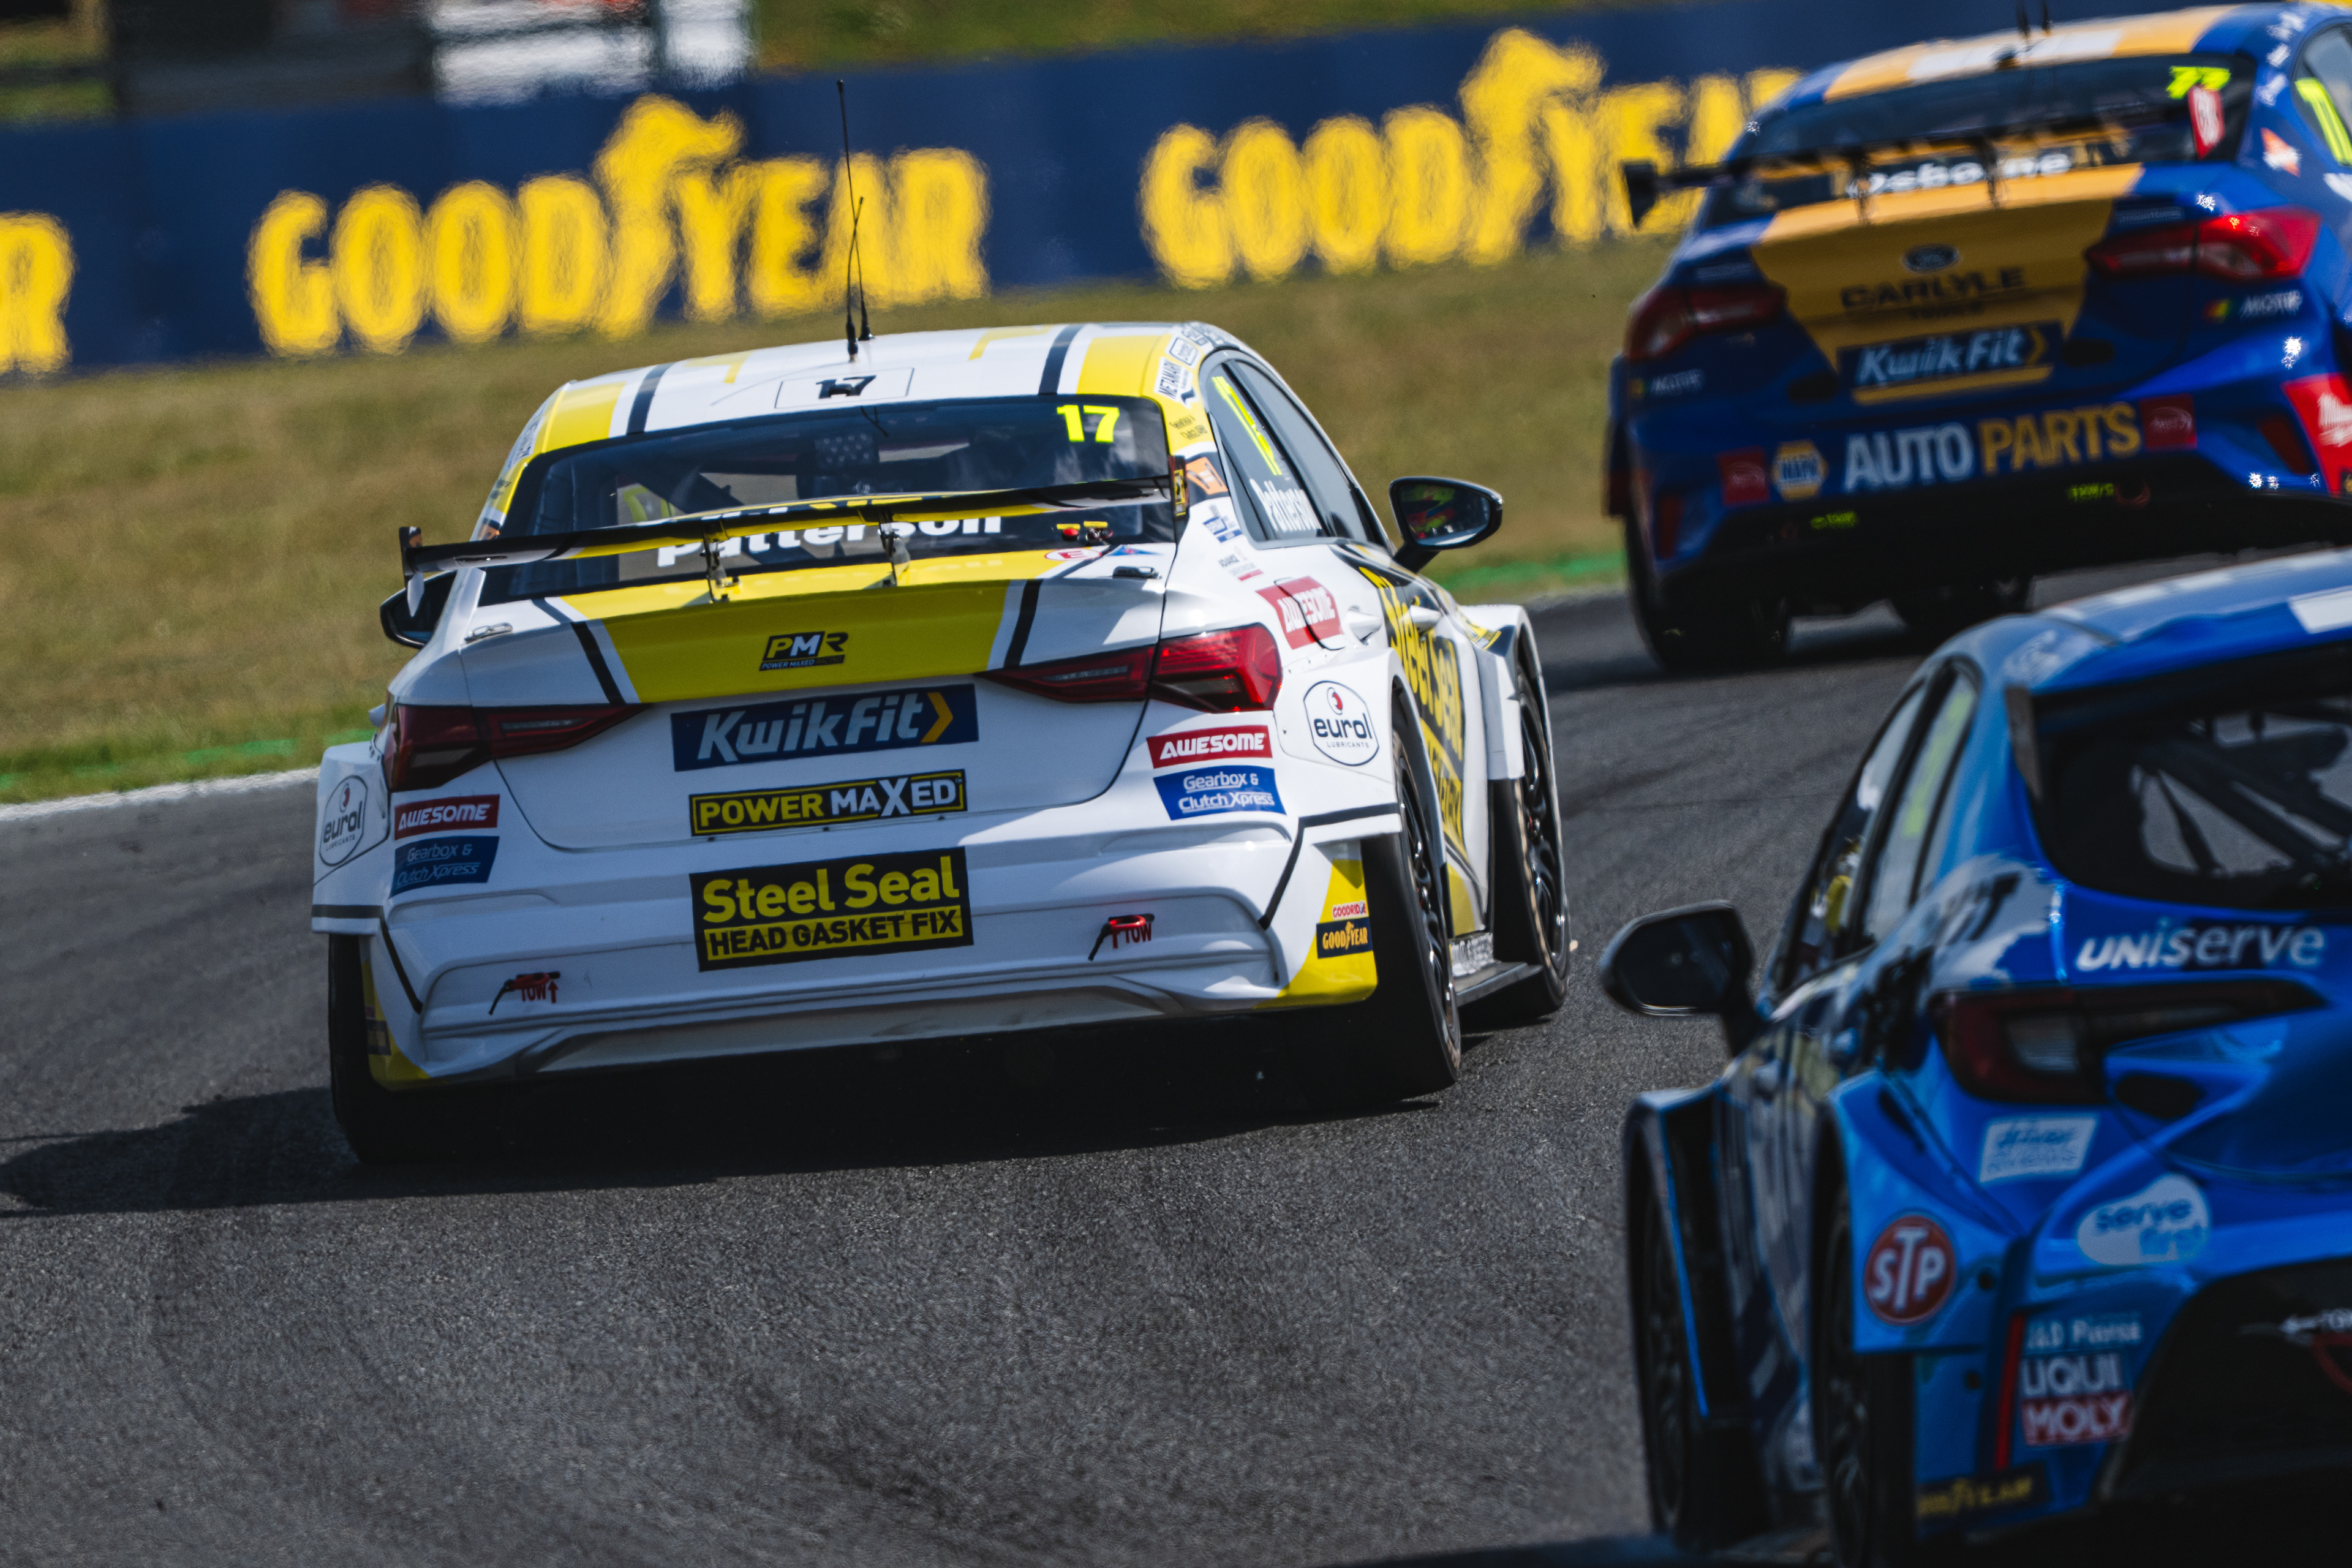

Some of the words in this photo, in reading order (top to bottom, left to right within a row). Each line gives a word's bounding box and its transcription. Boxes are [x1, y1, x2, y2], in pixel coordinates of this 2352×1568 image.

[1137, 28, 1804, 289] GOODYEA
[1845, 153, 2073, 199] Osbone
[248, 95, 991, 358] GOODYEAR
[1839, 266, 2026, 309] CARLYLE
[1057, 404, 1120, 443] 17
[1842, 422, 1976, 494] AUTO
[1977, 401, 2142, 477] PARTS
[761, 661, 788, 670] POWER
[790, 658, 815, 668] MAXED
[767, 632, 849, 658] PMR
[1314, 712, 1373, 740] eurol
[1327, 741, 1370, 749] LUBRICANTS
[1159, 733, 1265, 761] AWESOME
[1183, 771, 1247, 791] Gearbox
[1250, 772, 1259, 785] &
[323, 800, 363, 843] eurol
[398, 804, 491, 831] AWESOME
[700, 793, 824, 827] POWER
[831, 777, 957, 817] MAXED
[1178, 794, 1229, 812] Clutch
[1228, 792, 1275, 808] Xpress
[407, 844, 458, 862] Gearbox
[429, 862, 480, 880] Xpress
[703, 868, 835, 923] Steel
[844, 856, 960, 908] Seal
[709, 926, 786, 957] HEAD
[792, 913, 907, 948] GASKET
[912, 909, 959, 937] FIX
[1322, 921, 1368, 949] GOODYEAR
[1871, 1229, 1948, 1312] STP
[2025, 1395, 2130, 1444] MOLY
